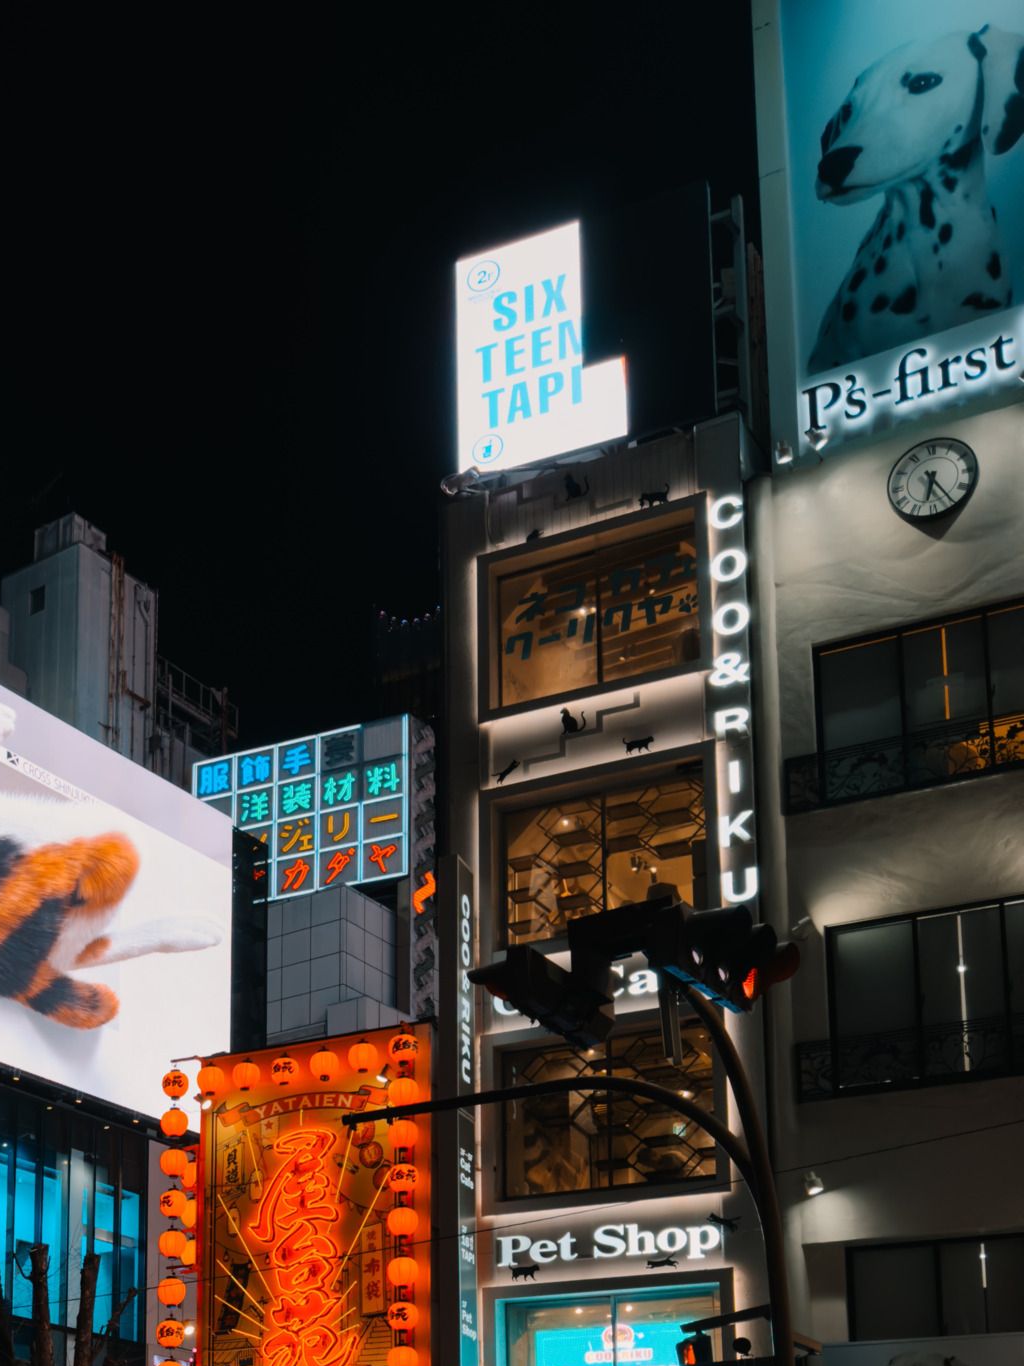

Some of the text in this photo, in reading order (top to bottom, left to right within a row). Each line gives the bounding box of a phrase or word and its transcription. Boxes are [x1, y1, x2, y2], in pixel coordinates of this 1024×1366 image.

[492, 273, 567, 333] SIX
[475, 319, 583, 385] TEEN
[481, 365, 583, 430] TAPI
[708, 496, 761, 903] COO&RIKU
[241, 763, 400, 822] 洋装材料
[254, 1094, 353, 1119] YATAIEN
[496, 1222, 723, 1269] Pet Shop
